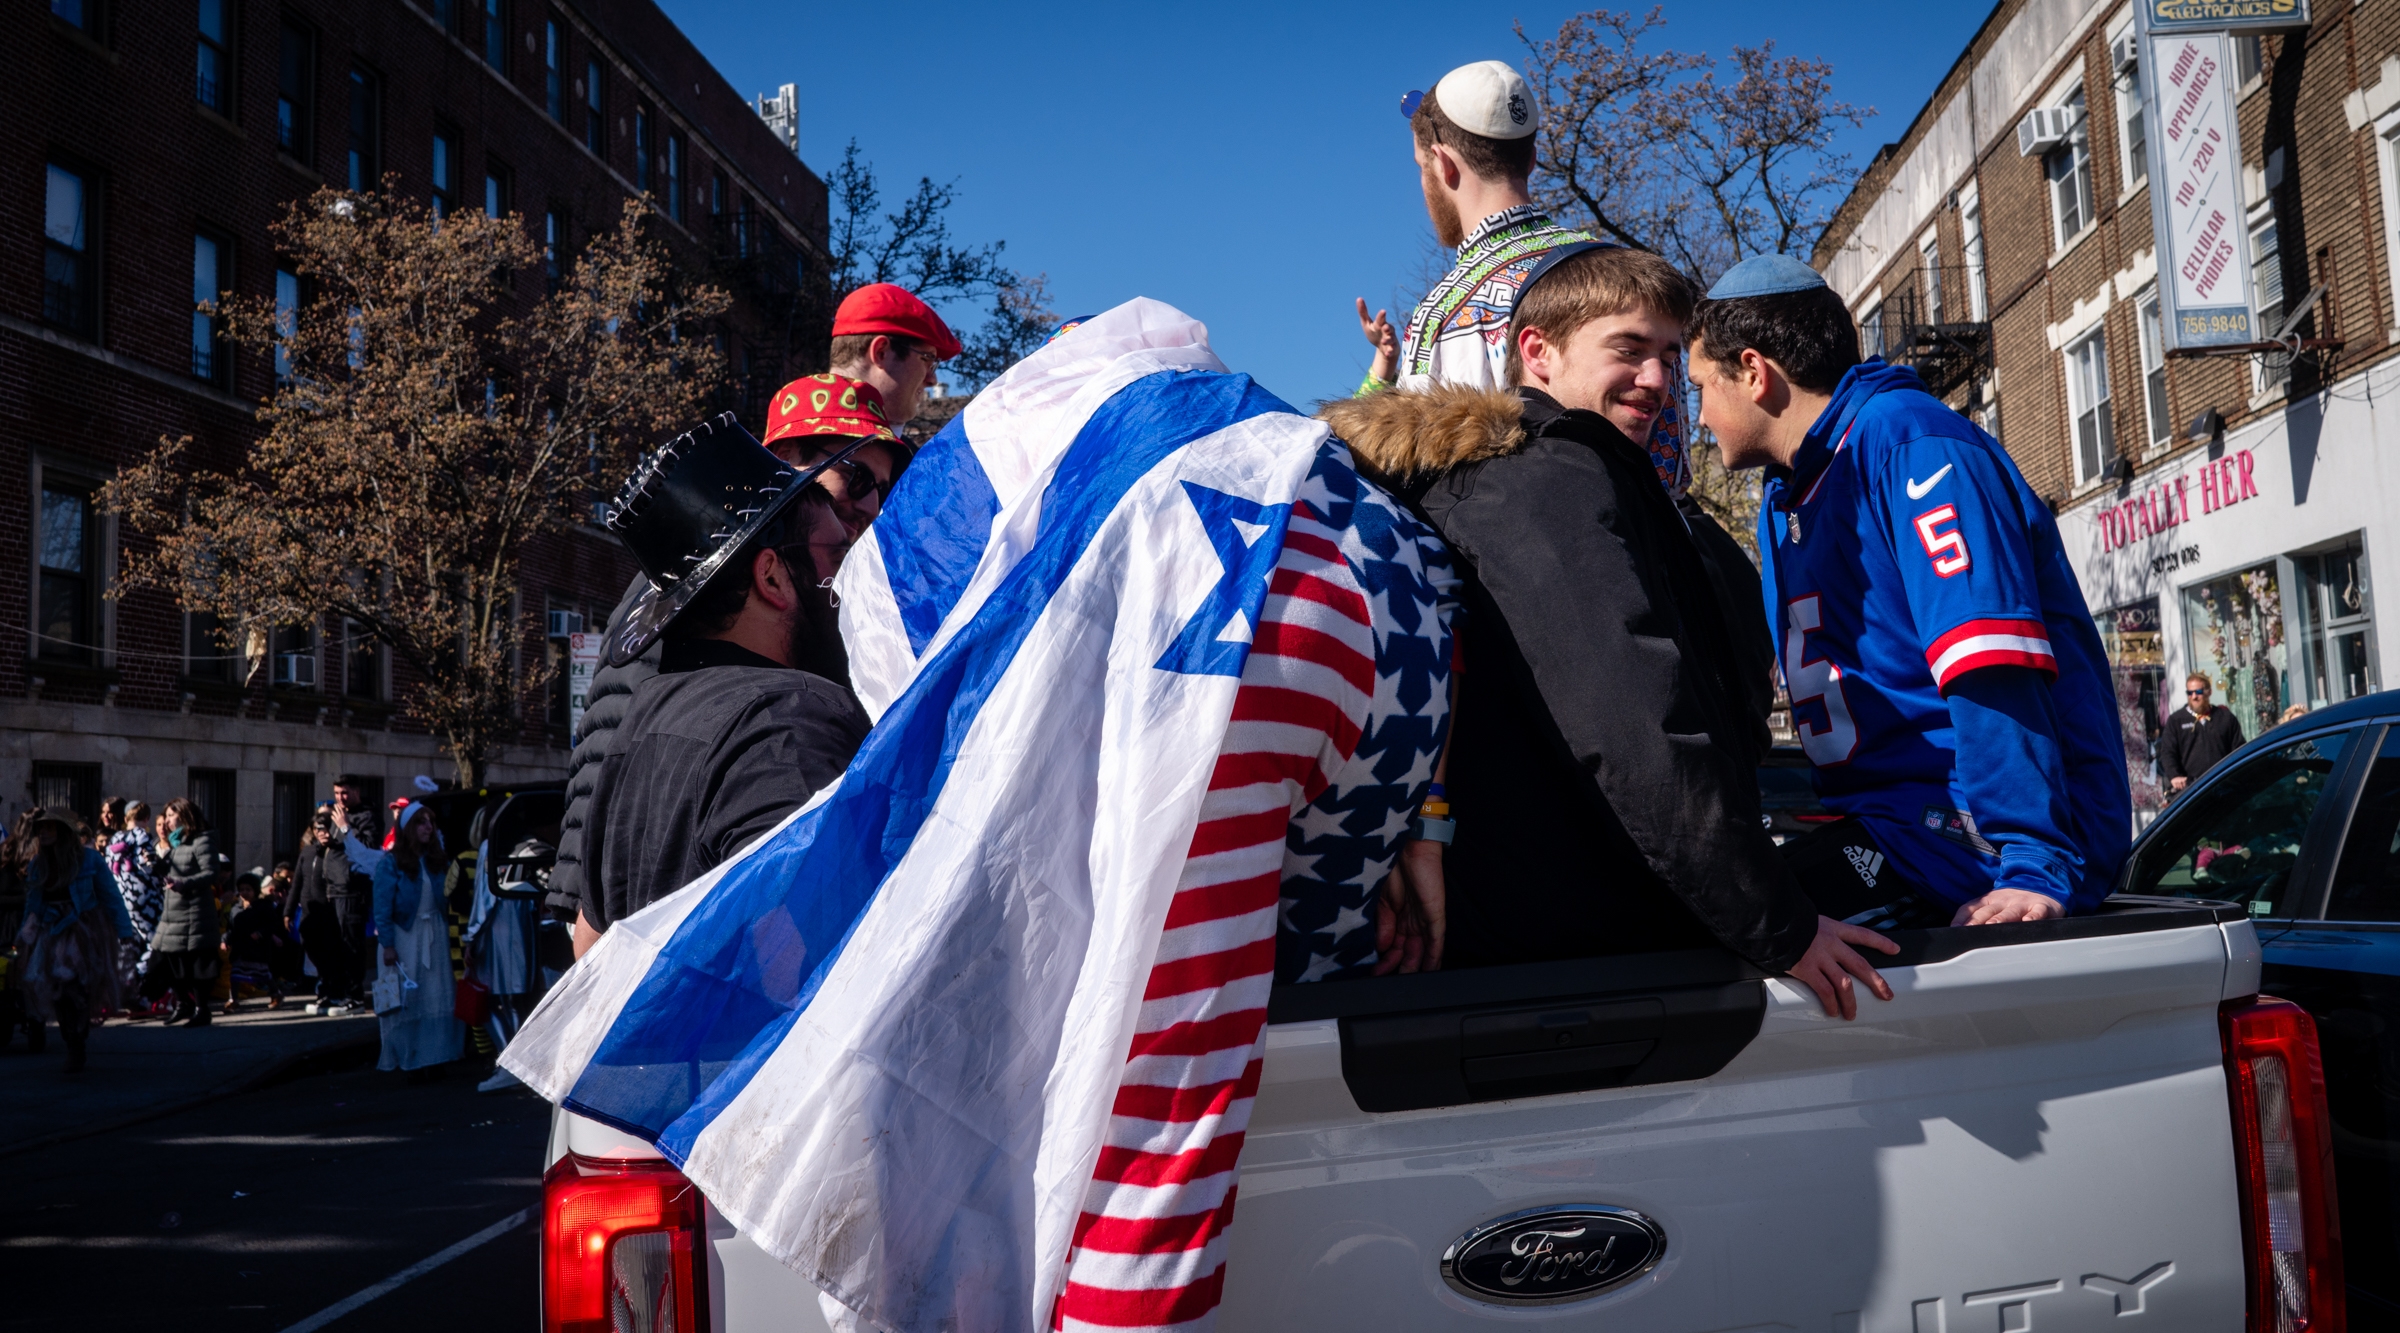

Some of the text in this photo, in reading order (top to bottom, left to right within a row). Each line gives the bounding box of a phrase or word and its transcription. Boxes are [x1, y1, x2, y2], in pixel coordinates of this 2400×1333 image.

[2169, 1, 2271, 20] ELECTRONICS
[2168, 40, 2200, 88] HOME
[2167, 56, 2217, 142] APPLIANCES
[2188, 169, 2201, 187] /
[2192, 141, 2215, 174] 220
[2175, 181, 2195, 208] 110
[2181, 209, 2227, 282] CELLULAR
[2195, 239, 2234, 300] PHONES
[2182, 313, 2247, 335] 756-9840
[2097, 448, 2259, 554] TOTALLY HER
[1913, 503, 1972, 579] 5
[1784, 591, 1861, 769] 5
[1843, 846, 1877, 888] adidas
[1501, 1227, 1616, 1286] Ford
